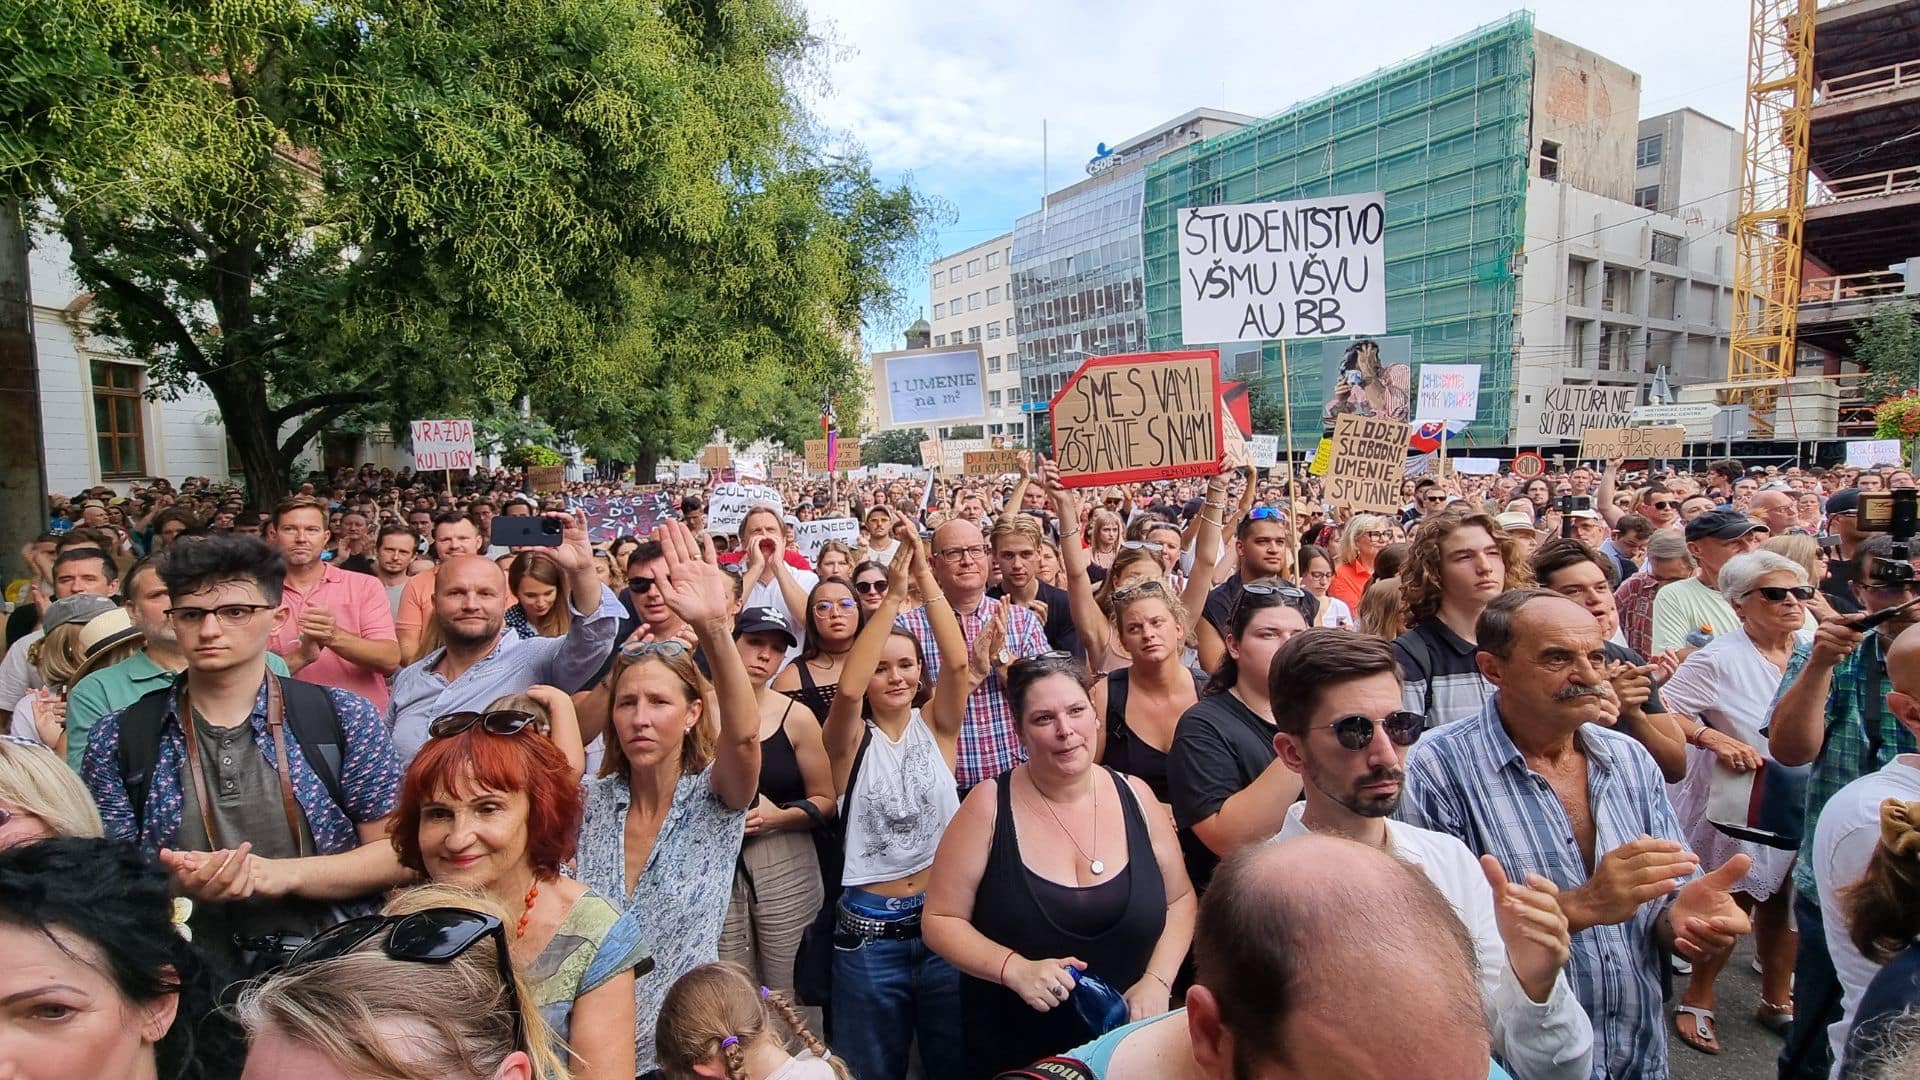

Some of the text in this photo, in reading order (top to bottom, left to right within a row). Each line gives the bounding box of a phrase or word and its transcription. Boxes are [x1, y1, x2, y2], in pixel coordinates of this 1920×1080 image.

[1185, 202, 1384, 256] ŠTUDENTSTVO
[1189, 253, 1369, 300] VŠMU VŠVU
[1238, 299, 1346, 339] AU BB
[892, 374, 977, 393] 1 UMENIE
[1073, 367, 1209, 424] SME S VAMI,
[915, 396, 936, 407] na
[1545, 387, 1635, 414] KULTÚRA NIE
[1540, 411, 1555, 435] SÚ
[1556, 413, 1576, 436] IBA
[1618, 428, 1654, 443] GDE
[1147, 415, 1165, 467] S
[1167, 412, 1213, 466] NAMI
[715, 487, 779, 501] CULTURE
[1331, 477, 1399, 505] SPÚTANÉ
[797, 522, 855, 535] WE NEED
